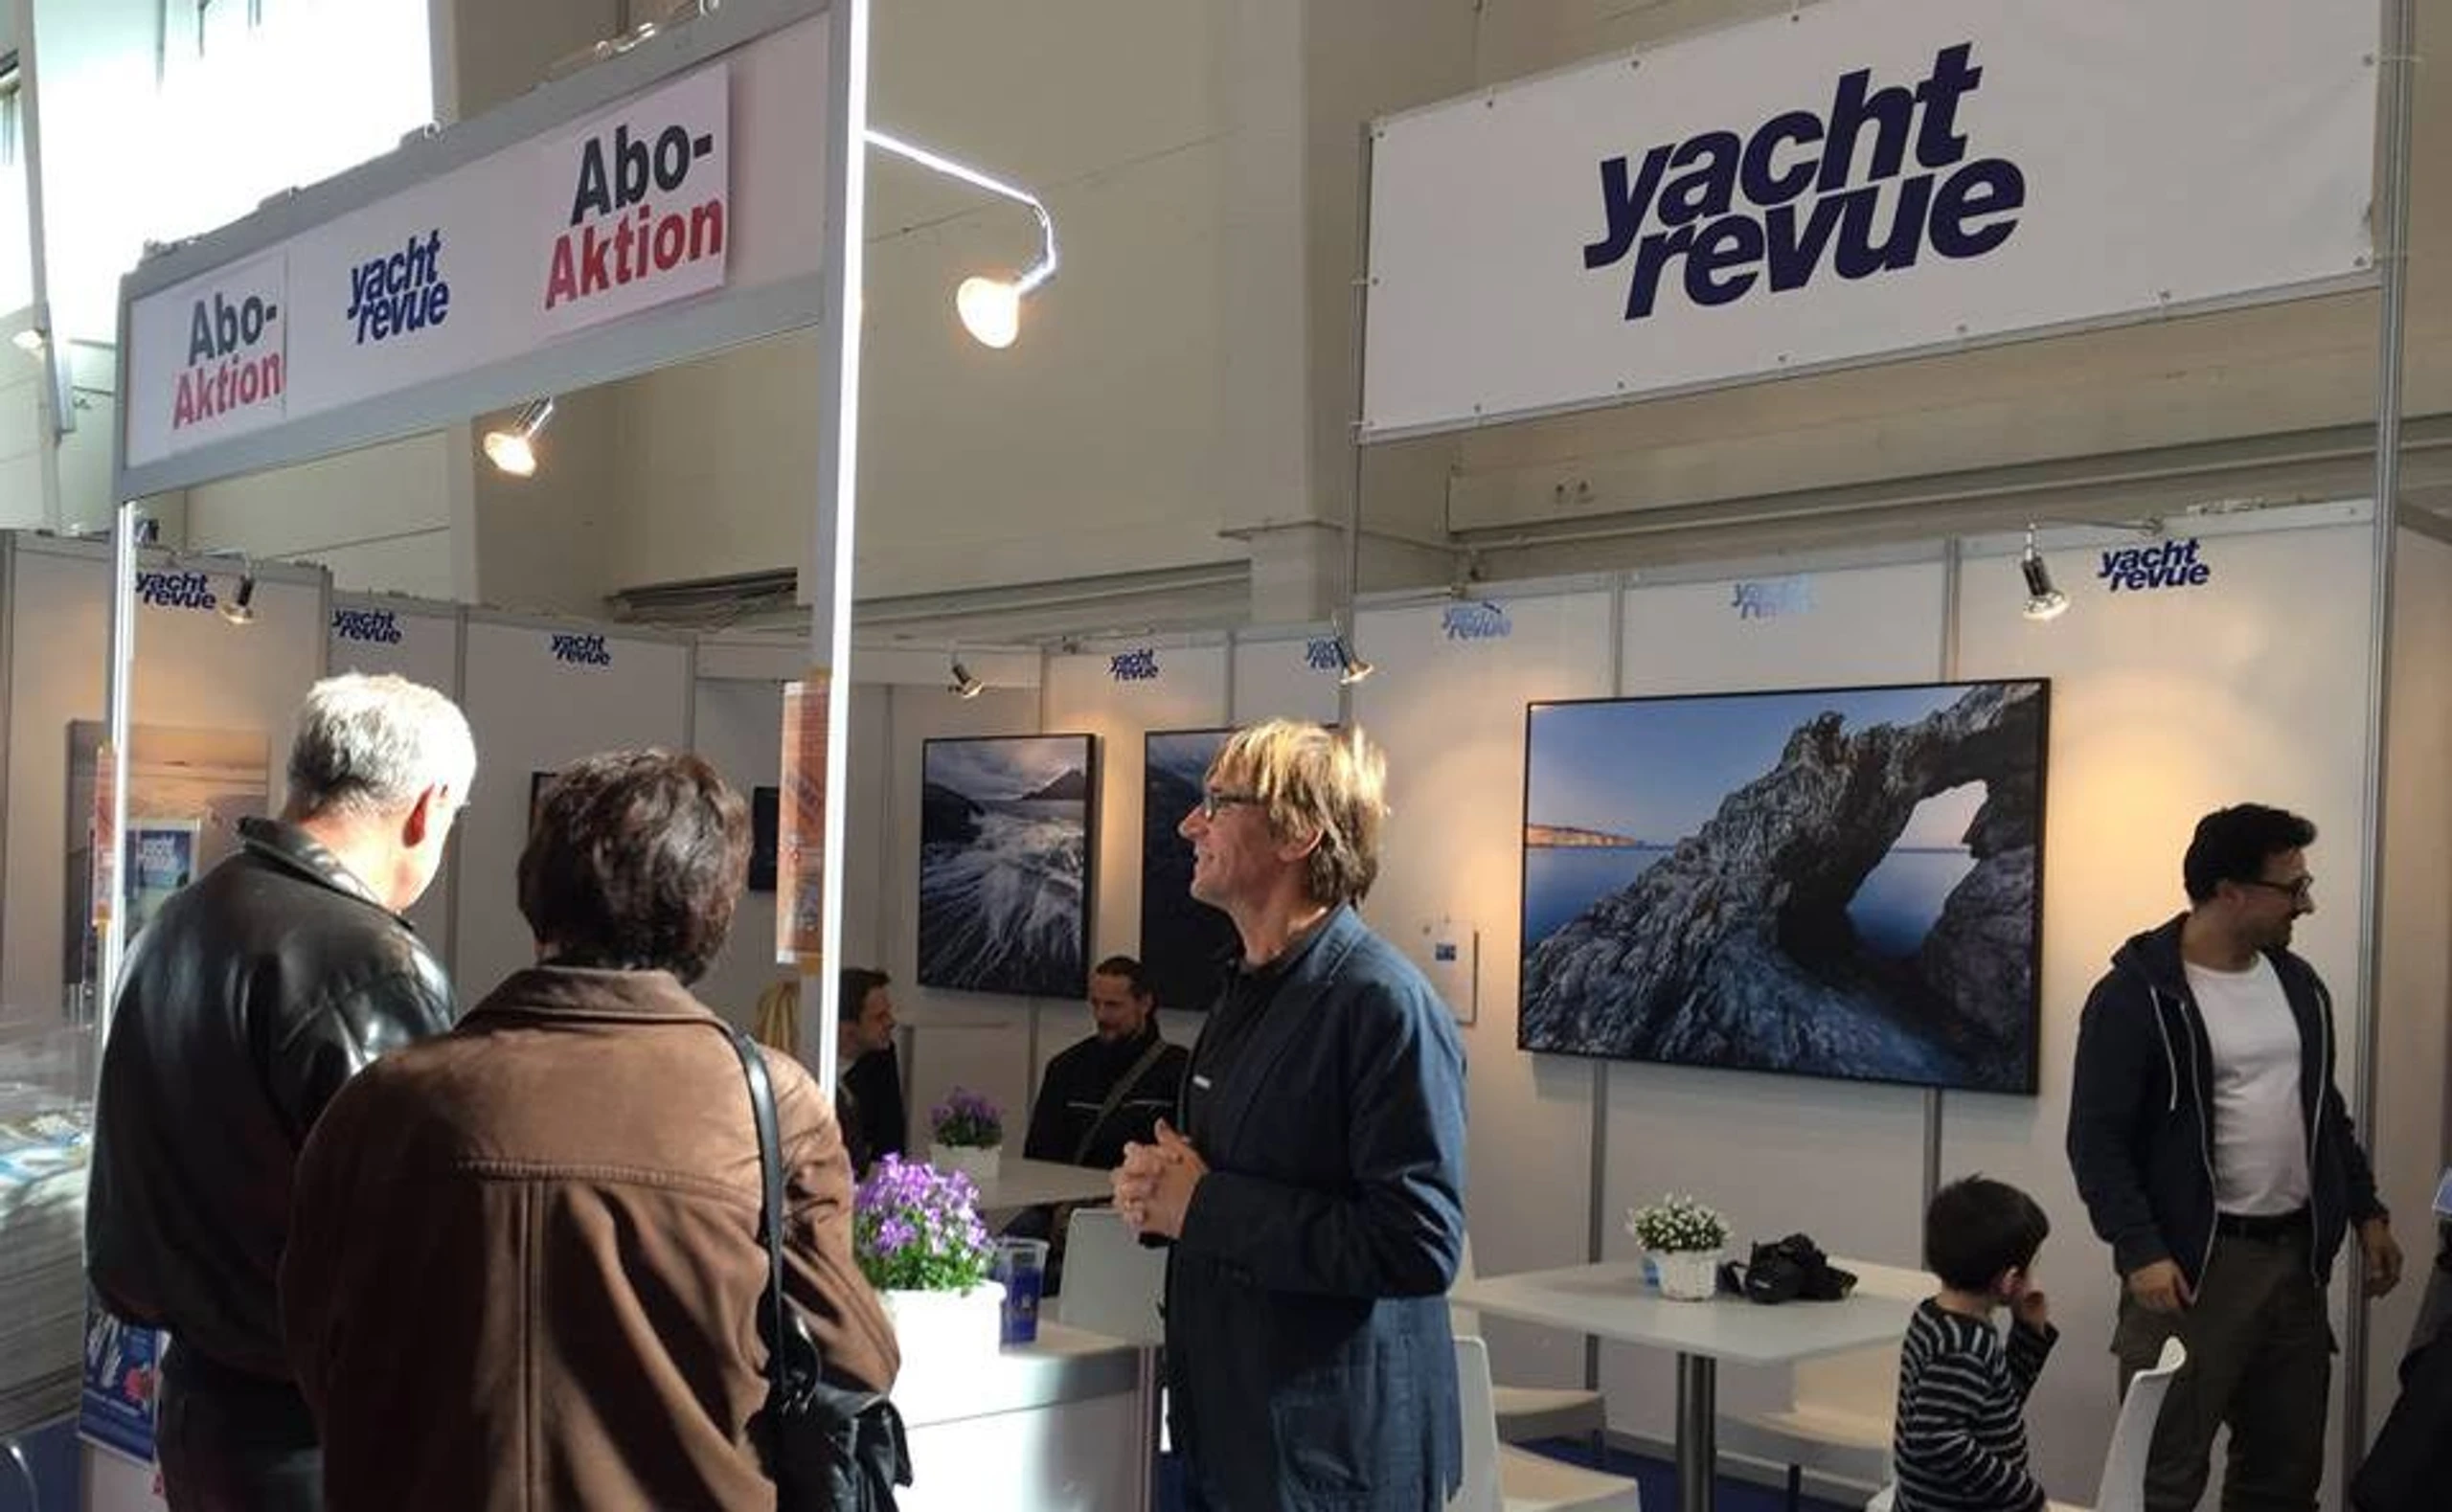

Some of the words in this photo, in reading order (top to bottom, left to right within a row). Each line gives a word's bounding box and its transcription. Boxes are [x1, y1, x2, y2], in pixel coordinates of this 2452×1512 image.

[571, 124, 713, 226] Abo-
[1583, 42, 1983, 269] yacht
[546, 198, 723, 310] Aktion
[1624, 157, 2026, 321] revue
[347, 228, 441, 320] yacht
[189, 292, 277, 367] Abo-
[357, 282, 450, 345] revue
[173, 352, 281, 430] Aktion
[135, 572, 208, 594] yacht
[2097, 537, 2200, 578] yacht
[2109, 562, 2211, 592] revue
[143, 588, 216, 609] revue
[331, 607, 395, 627] yacht
[339, 624, 401, 644] revue
[551, 633, 604, 651] yacht
[556, 648, 611, 666] revue
